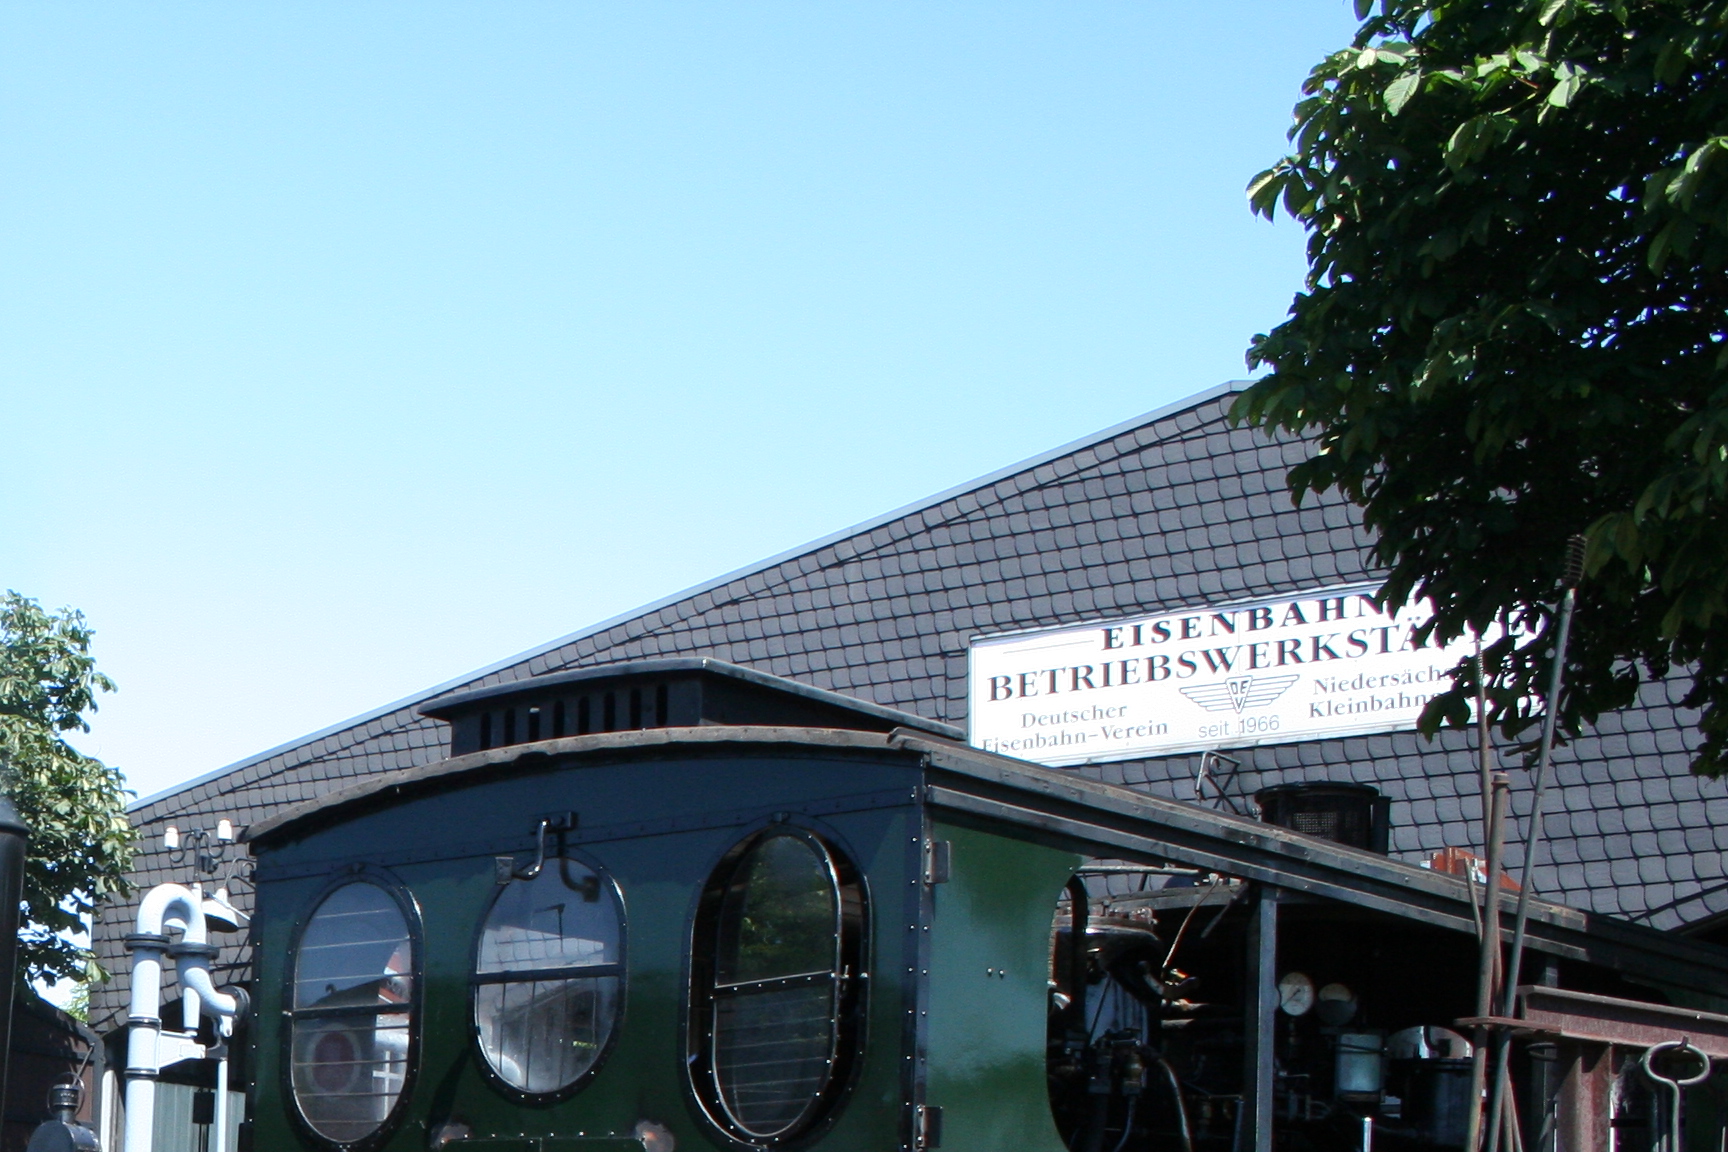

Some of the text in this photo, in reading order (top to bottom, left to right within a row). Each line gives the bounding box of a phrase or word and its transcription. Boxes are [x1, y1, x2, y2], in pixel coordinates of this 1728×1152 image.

[987, 612, 1478, 702] BETRIEBSWERKSTÄ
[1021, 704, 1128, 729] Deutscher
[1308, 691, 1438, 718] Kleinbahn
[982, 720, 1169, 753] Eisenbahn-Verein
[1198, 714, 1280, 739] seit 1966
